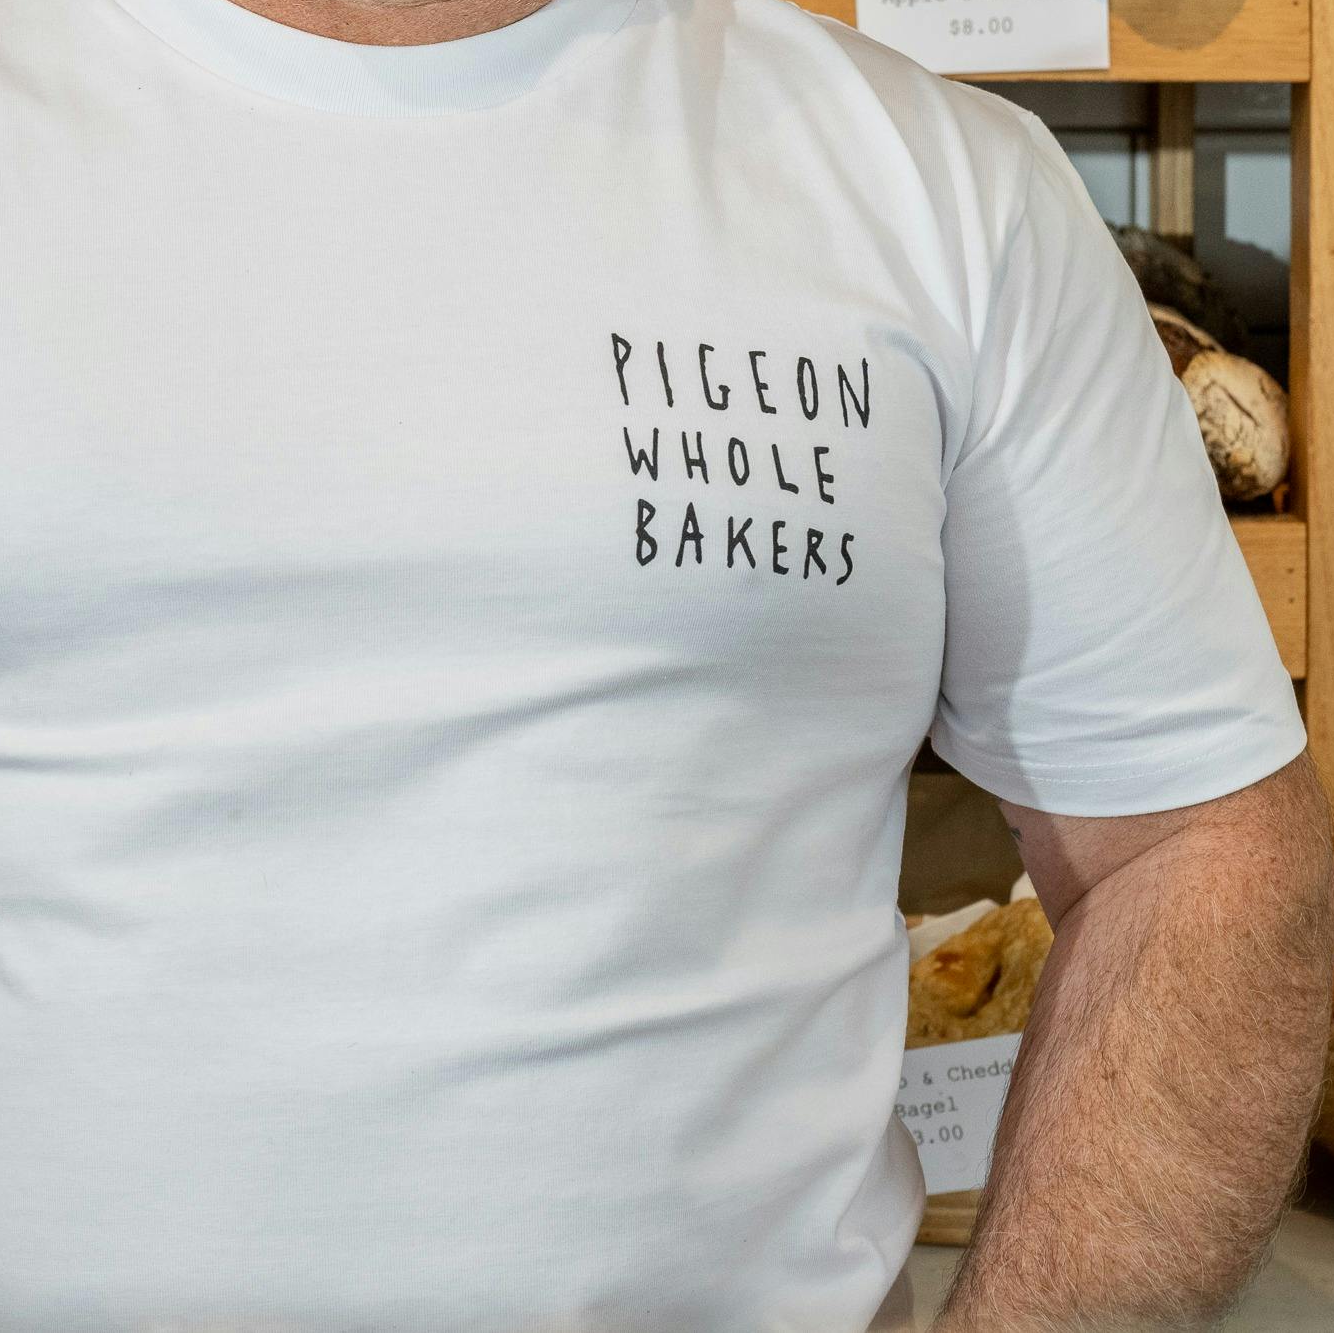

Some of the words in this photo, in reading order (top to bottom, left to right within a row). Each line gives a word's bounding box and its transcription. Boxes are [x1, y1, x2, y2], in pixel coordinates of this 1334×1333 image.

[949, 17, 1015, 36] $8.00
[611, 332, 870, 429] PIGEON
[623, 426, 835, 505] WHOLE
[636, 498, 855, 586] BAKERS
[947, 1058, 1014, 1082] Chedd
[894, 1096, 958, 1119] Bagel
[913, 1124, 964, 1146] 3.00
